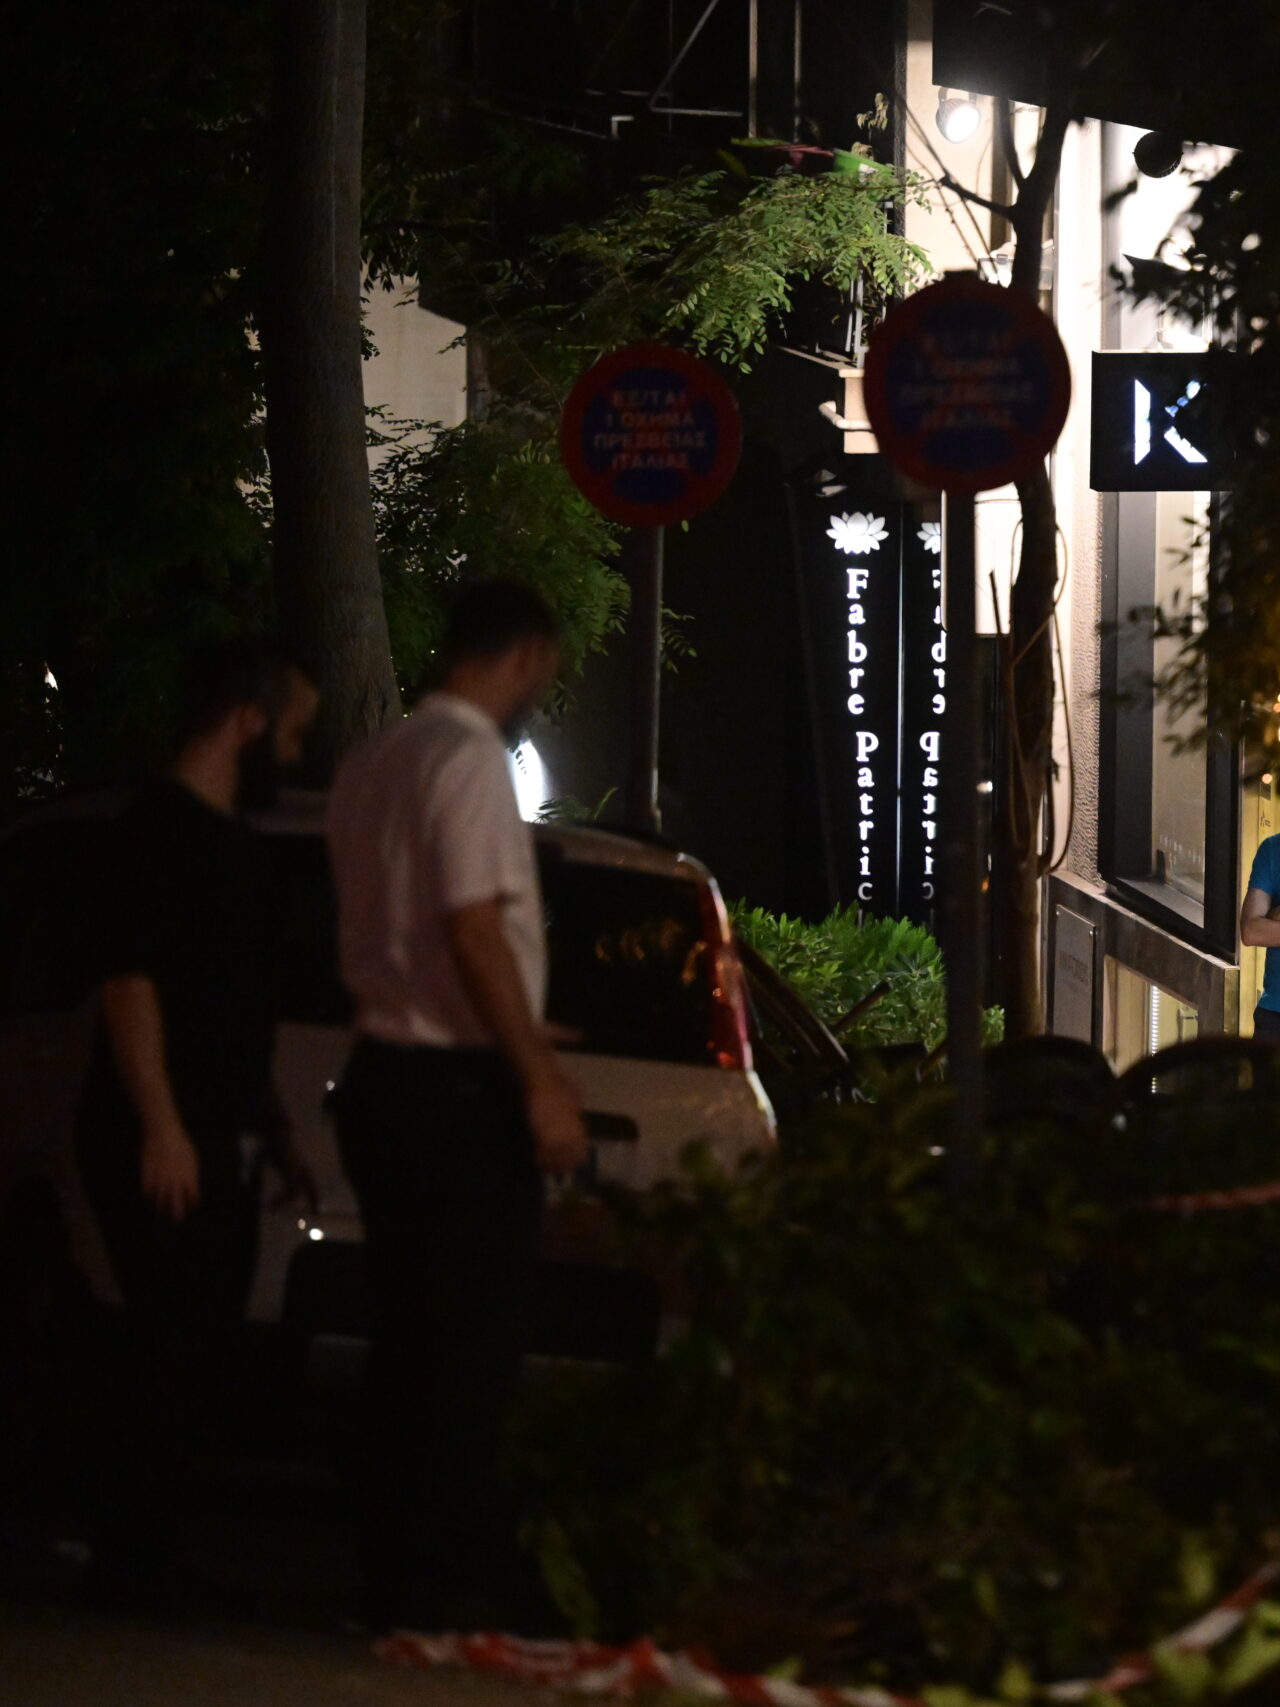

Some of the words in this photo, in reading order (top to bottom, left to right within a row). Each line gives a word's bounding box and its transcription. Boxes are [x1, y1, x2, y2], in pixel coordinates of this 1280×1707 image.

[593, 431, 706, 449] ΠΡΕΣΒΕΙΑΣ
[1134, 378, 1208, 465] K
[611, 452, 690, 471] ΙΤΑΛΙΑΣ
[846, 567, 869, 715] Fabre
